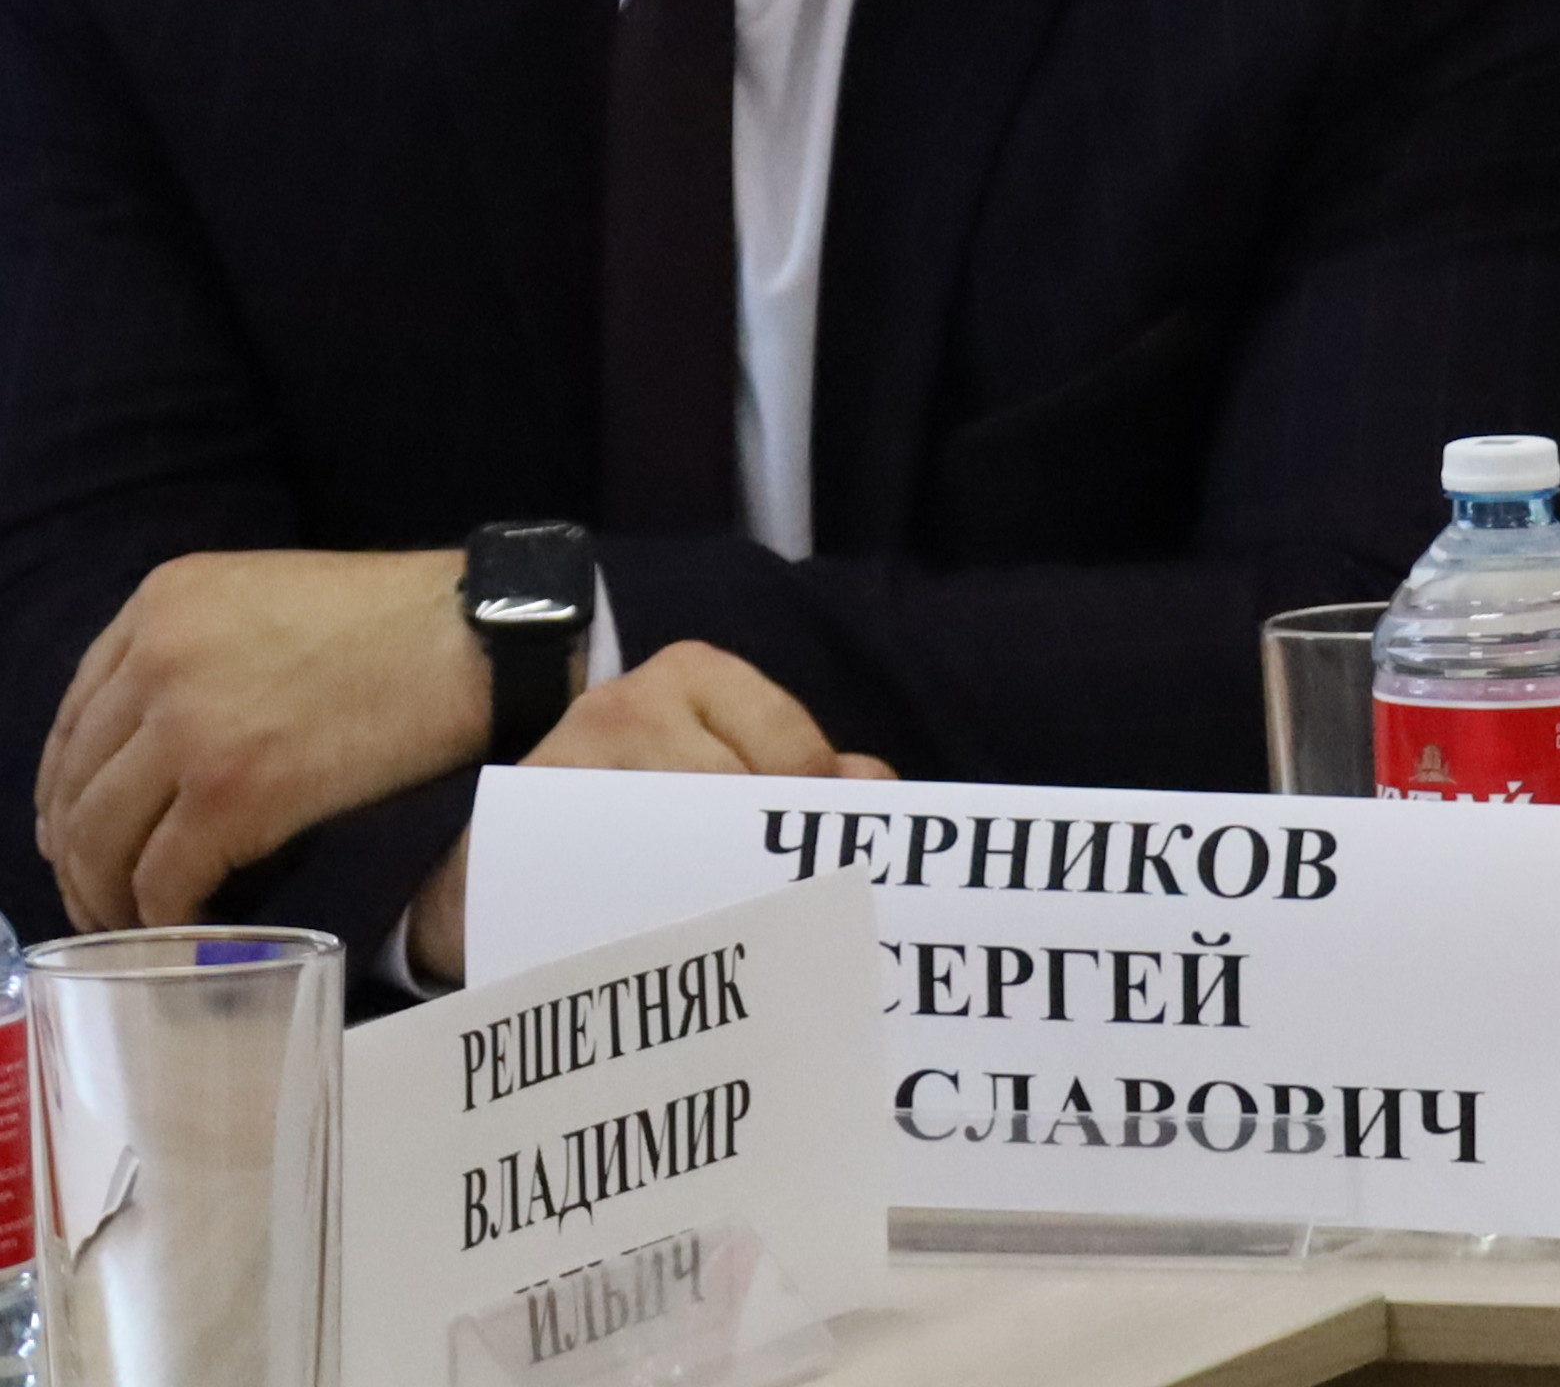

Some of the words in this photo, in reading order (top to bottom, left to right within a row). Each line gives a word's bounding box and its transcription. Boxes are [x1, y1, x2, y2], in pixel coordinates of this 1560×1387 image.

[759, 809, 1338, 900] ЧЕРНИКОВ
[459, 942, 750, 1114] РЕШЕТНЯК
[460, 1078, 751, 1252] ВЛАДИМИР
[893, 1068, 1486, 1164] СЛАВОВИЧ
[513, 1227, 706, 1365] ИЛЬИЧ
